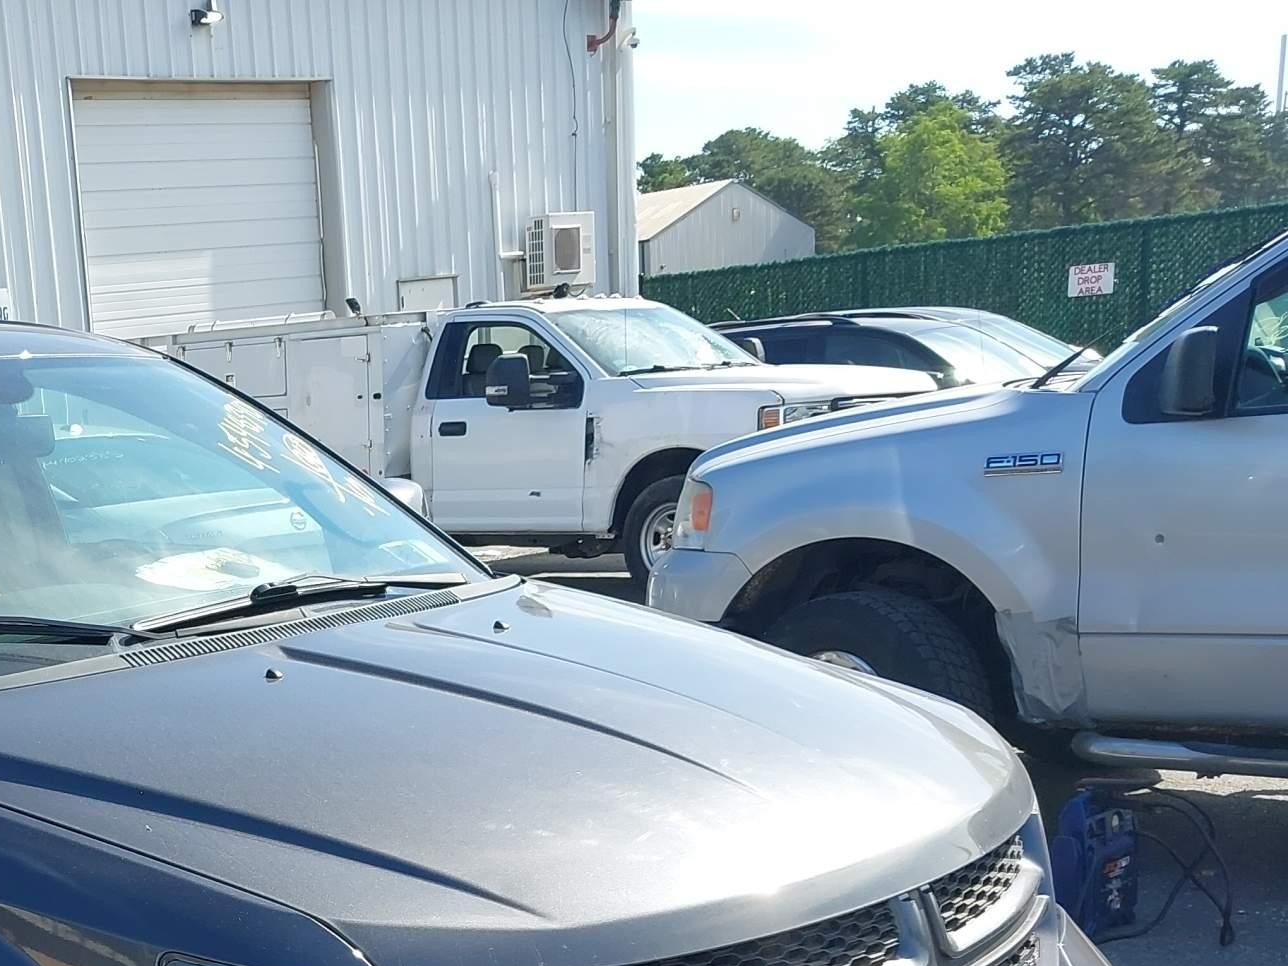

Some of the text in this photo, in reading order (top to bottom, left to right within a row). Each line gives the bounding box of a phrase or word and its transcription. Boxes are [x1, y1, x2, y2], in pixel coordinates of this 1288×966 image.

[1074, 264, 1108, 275] DEALER
[1077, 275, 1103, 286] DROP
[1077, 286, 1103, 297] AREA
[987, 453, 1061, 468] F-150
